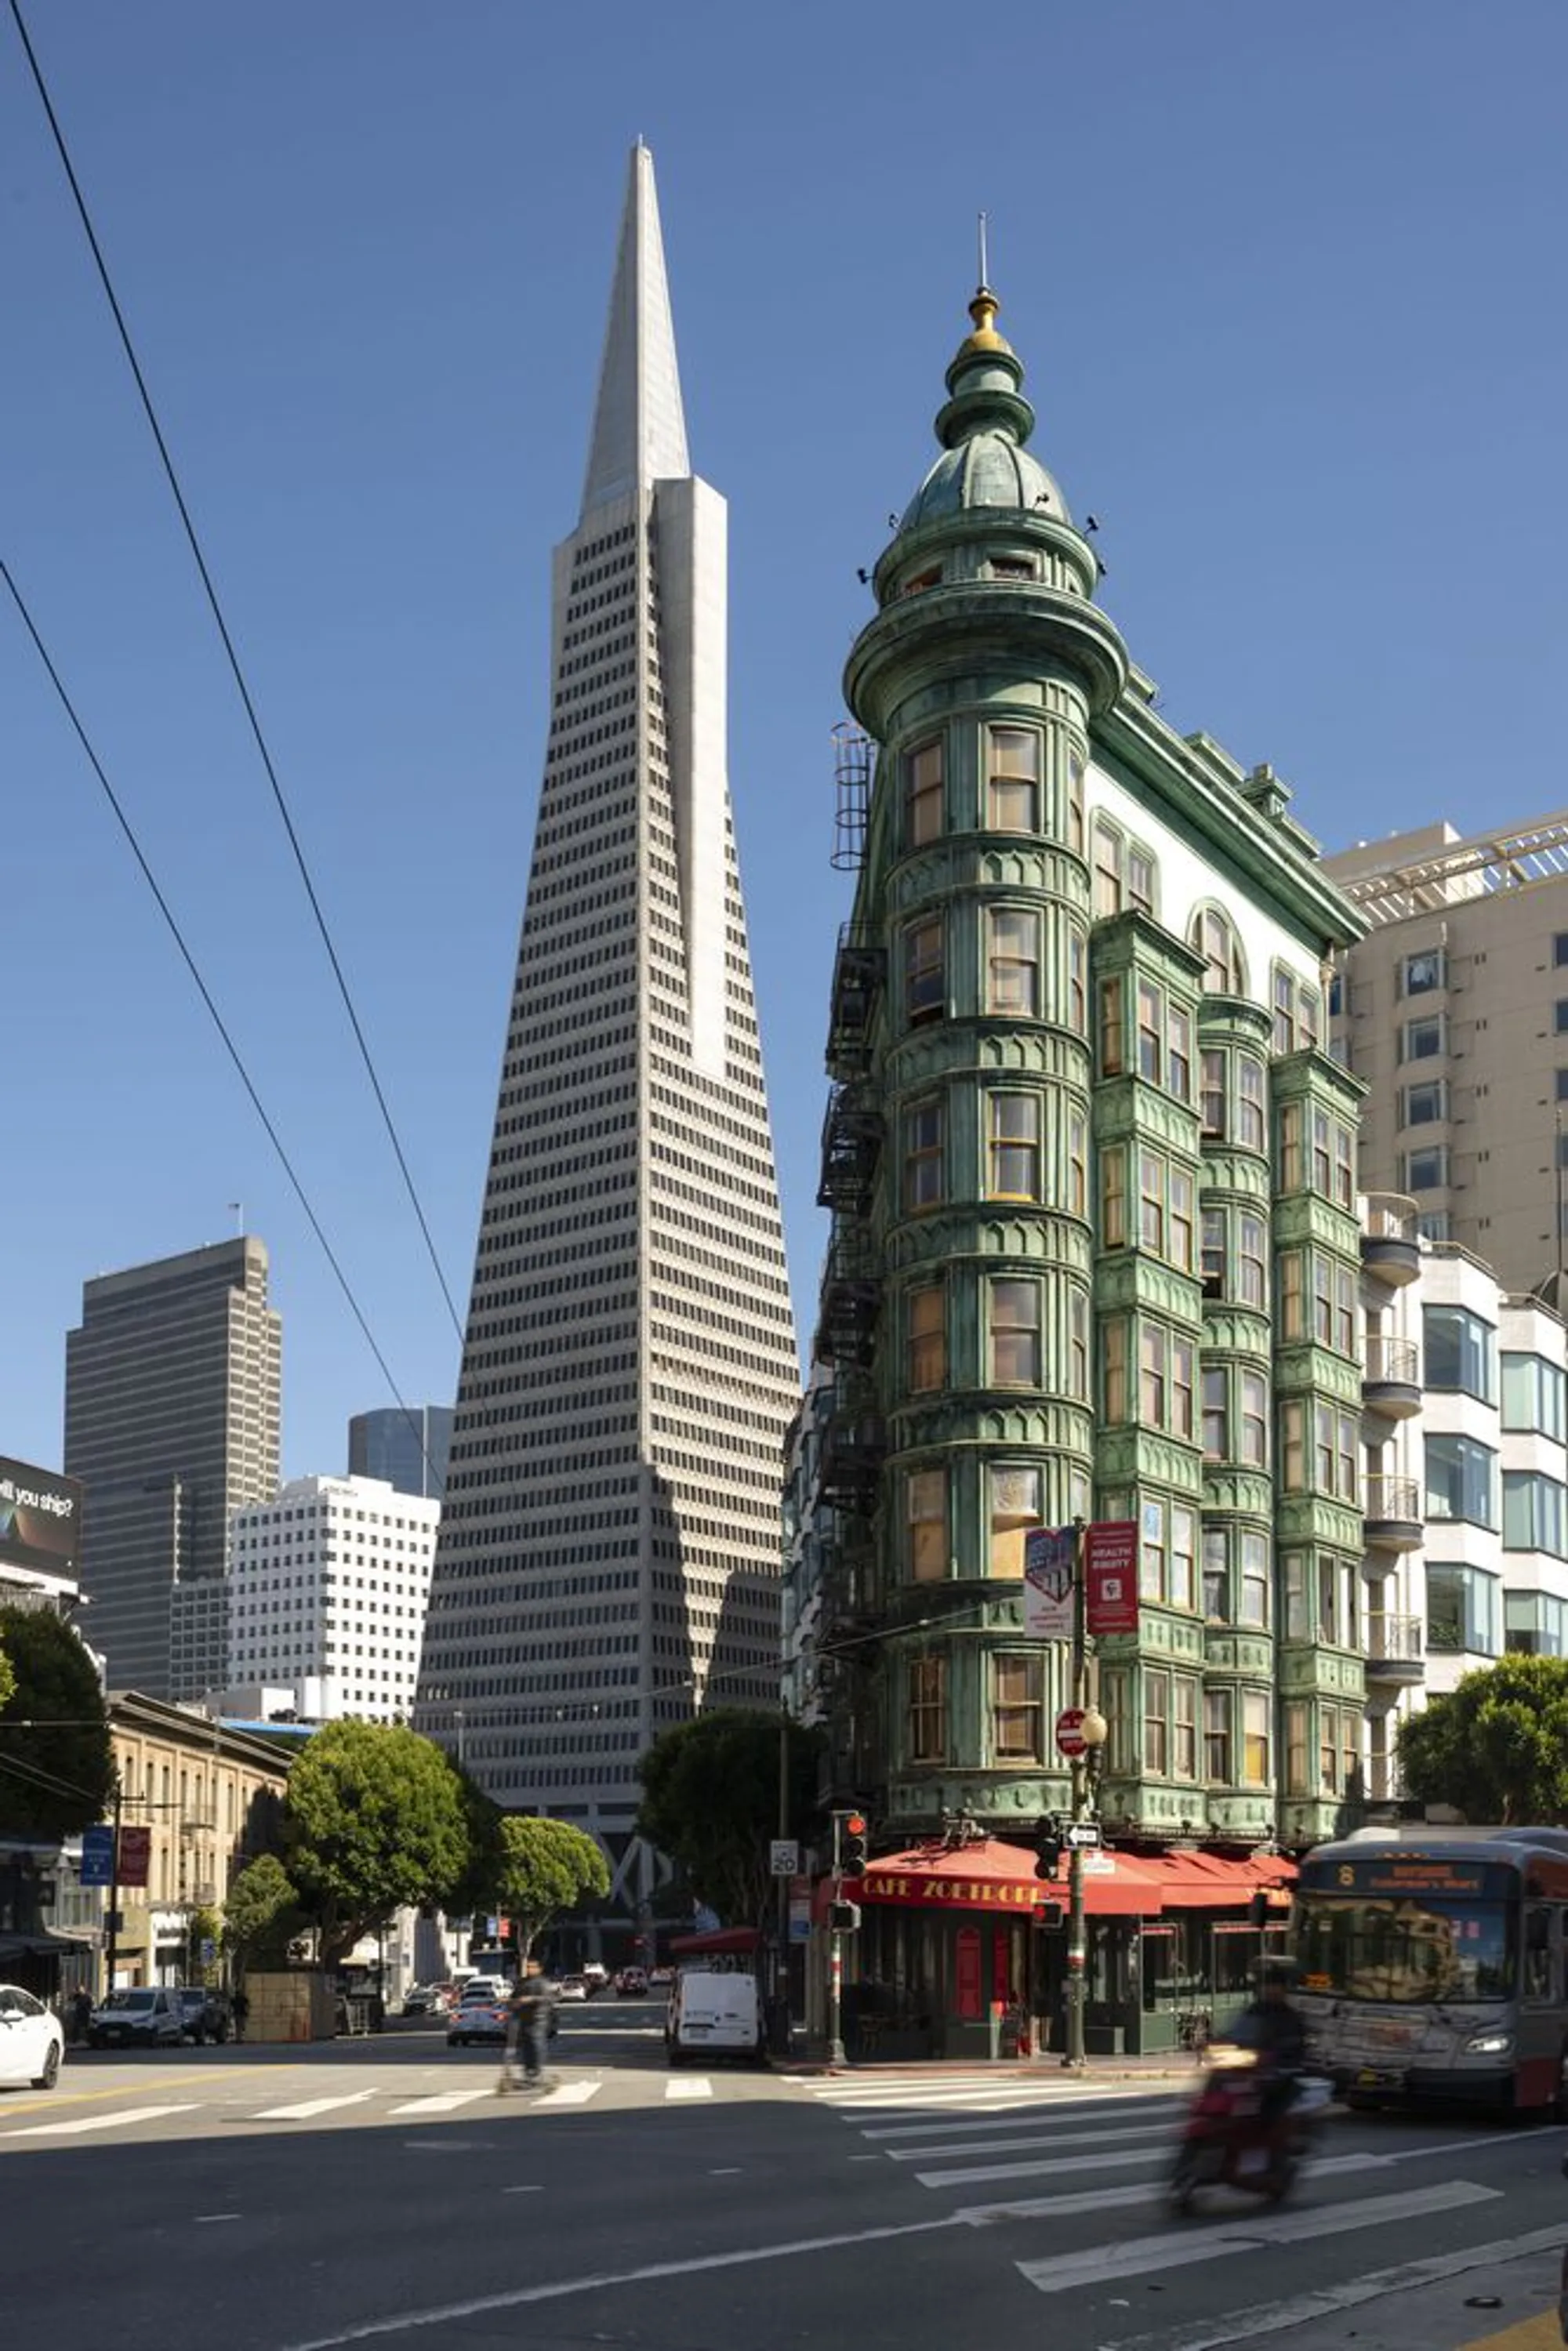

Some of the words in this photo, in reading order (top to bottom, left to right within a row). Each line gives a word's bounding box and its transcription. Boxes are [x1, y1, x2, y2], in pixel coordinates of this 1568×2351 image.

[0, 1478, 15, 1500] ill
[16, 1487, 39, 1507] you
[40, 1493, 74, 1518] ship?
[1091, 1547, 1133, 1558] HEALTH
[774, 1858, 796, 1872] 20
[1338, 1864, 1355, 1886] 8
